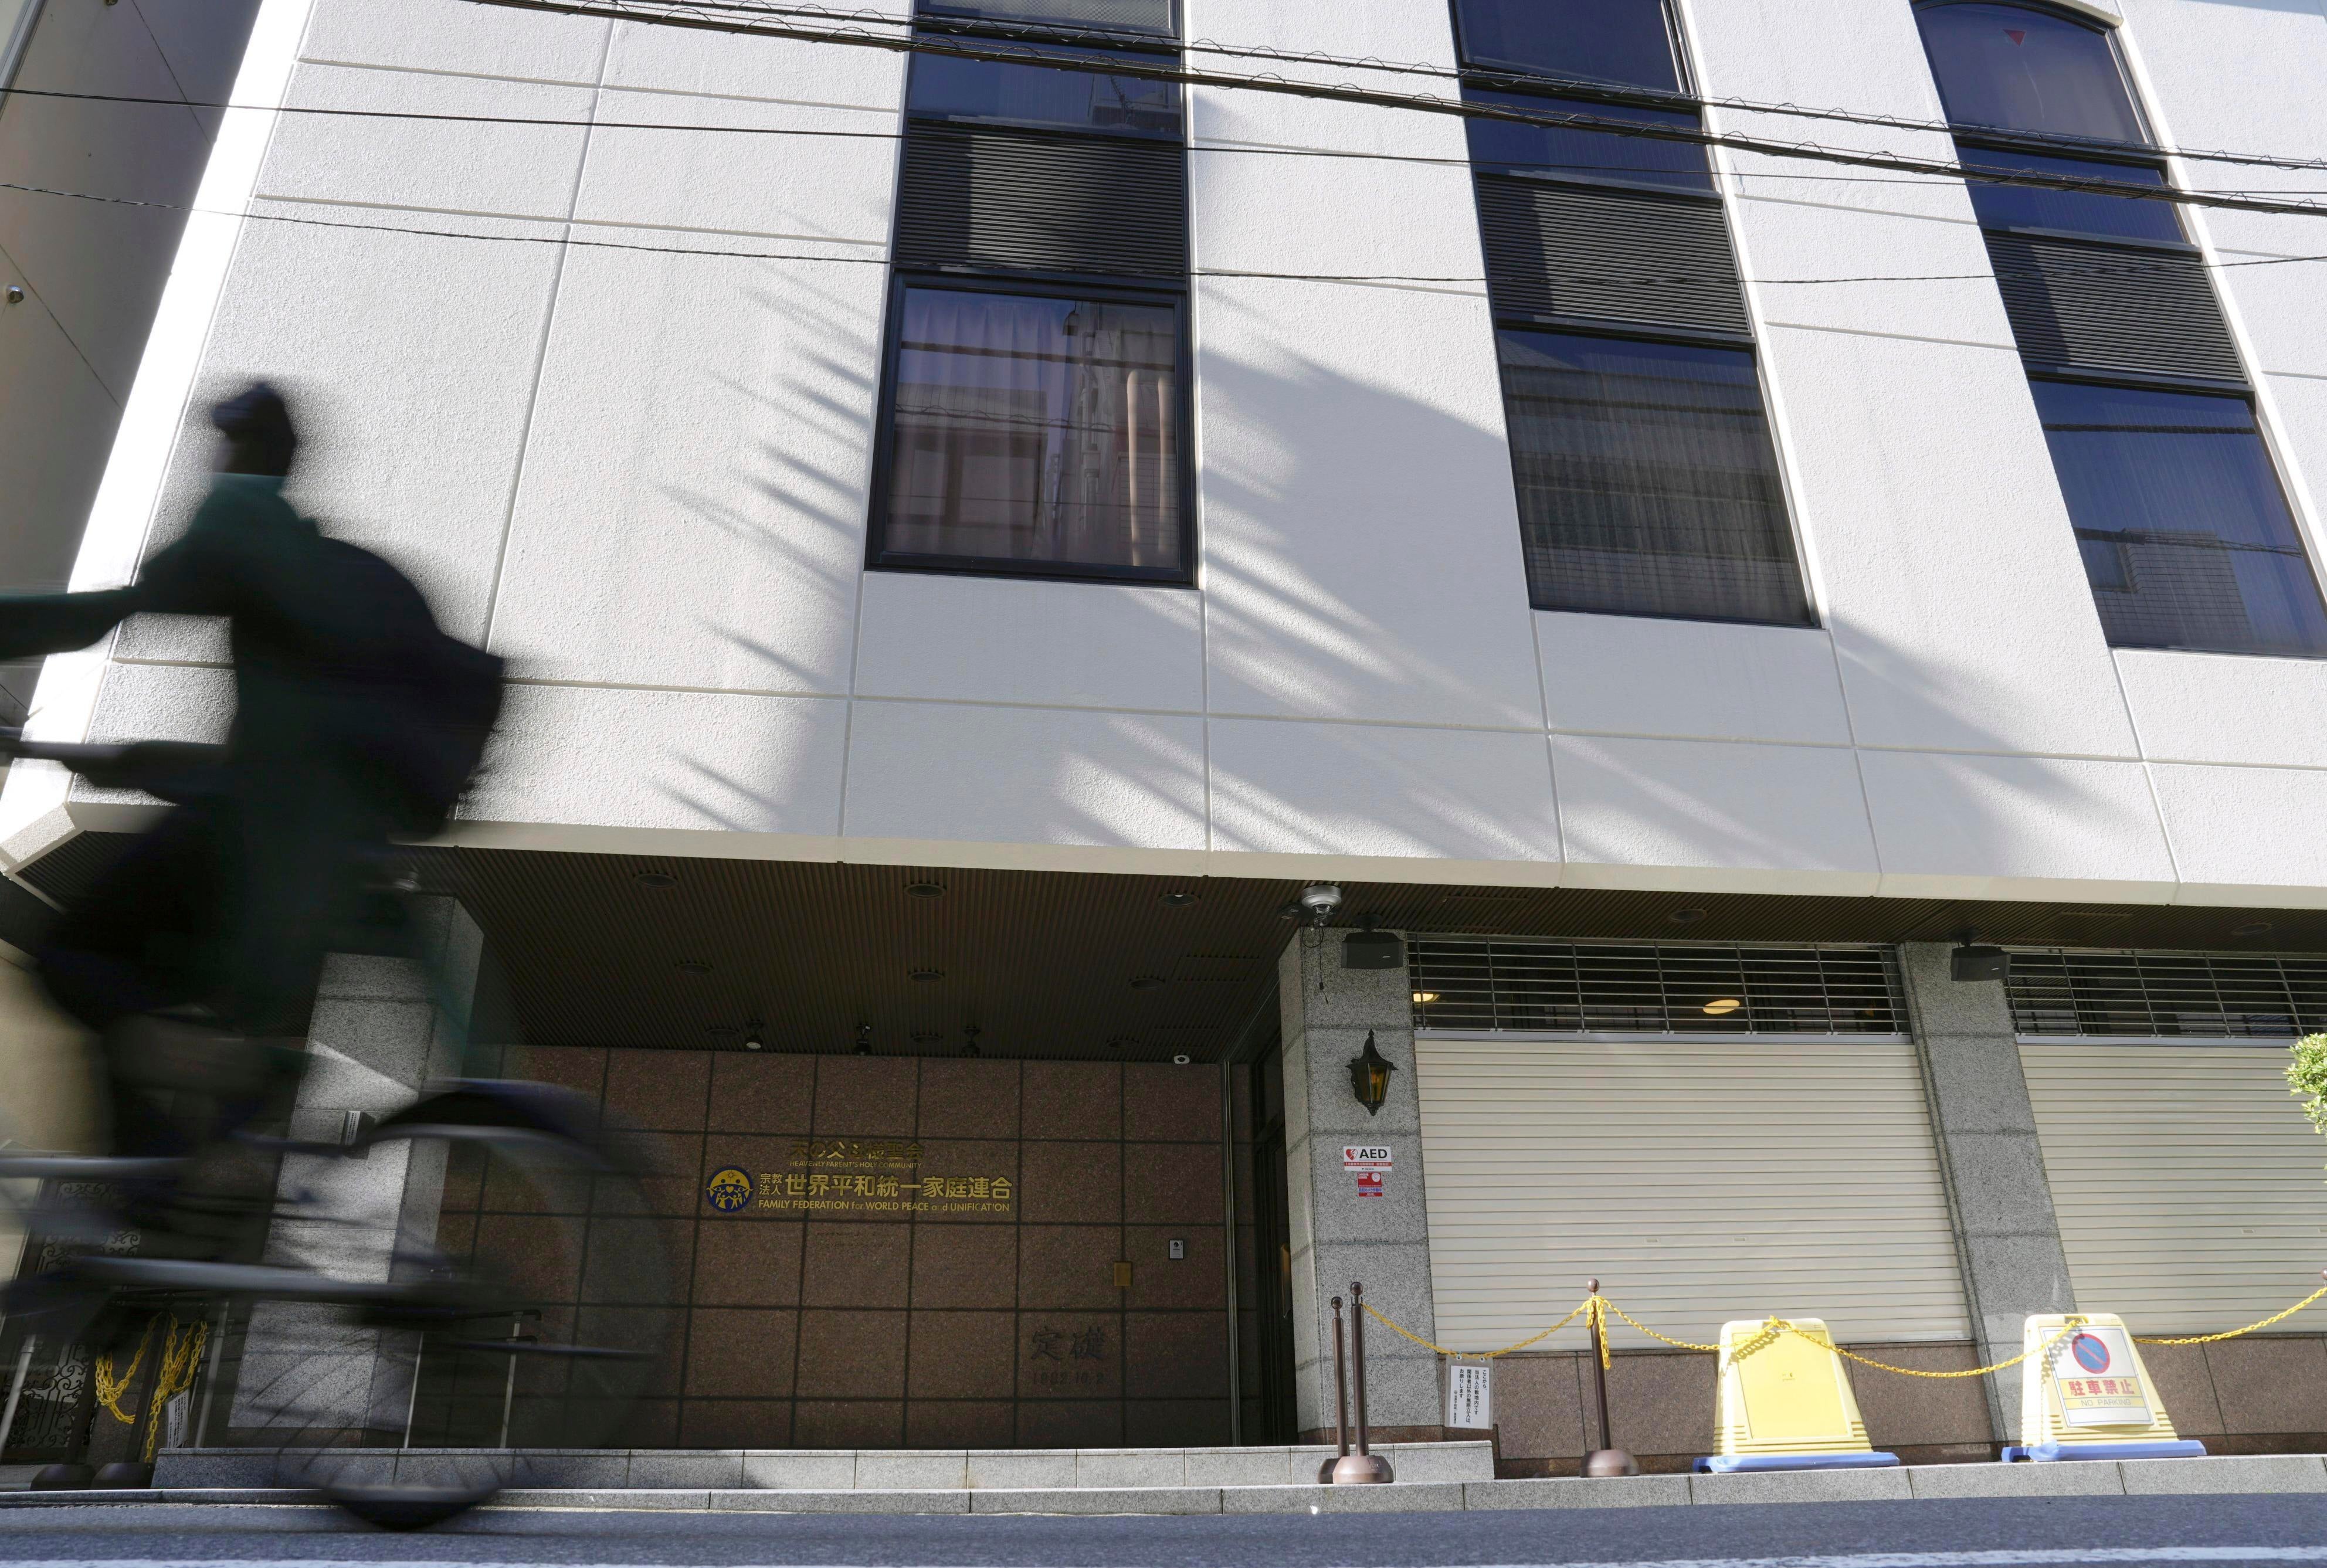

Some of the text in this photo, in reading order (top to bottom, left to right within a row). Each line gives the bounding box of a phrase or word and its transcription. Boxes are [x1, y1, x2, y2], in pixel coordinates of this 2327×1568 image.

[1359, 1149, 1388, 1159] AED
[760, 1173, 782, 1184] 宗教
[759, 1185, 781, 1195] 法人
[785, 1173, 1012, 1199] 世界平和統一家庭連合
[758, 1200, 791, 1209] FAMILY
[793, 1200, 849, 1210] FEDERATION
[852, 1201, 864, 1210] for
[866, 1202, 898, 1210] WORLD
[901, 1202, 929, 1211] PEACE
[950, 1203, 1009, 1211] UNIFICATION
[2068, 1379, 2135, 1397] 駐車禁止
